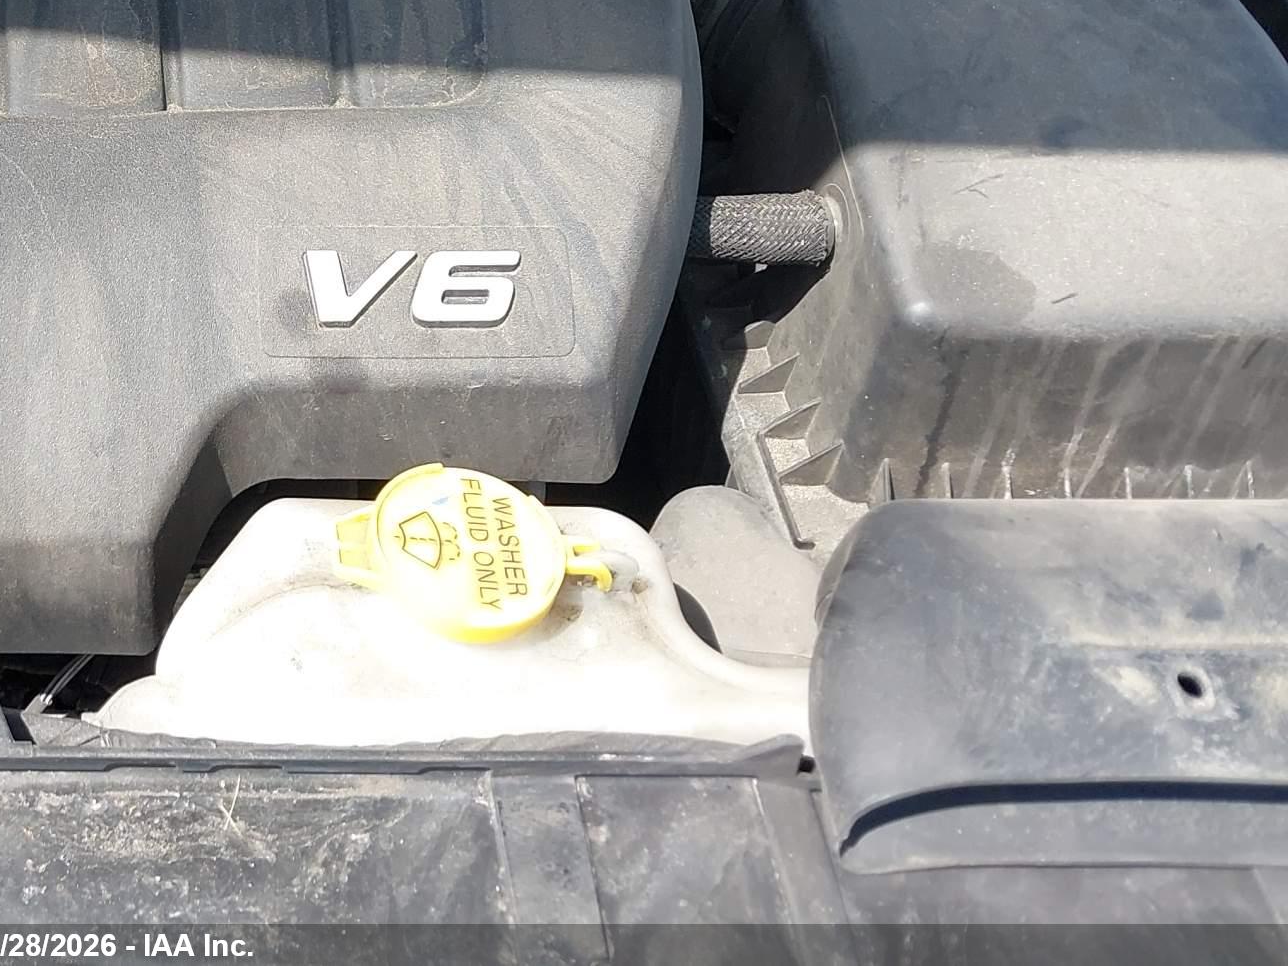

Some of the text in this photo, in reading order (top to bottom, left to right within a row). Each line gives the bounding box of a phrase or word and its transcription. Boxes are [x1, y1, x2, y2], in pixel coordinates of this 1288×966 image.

[303, 250, 521, 328] V6
[460, 478, 503, 610] FLUID ONLY
[492, 497, 528, 596] WASHER
